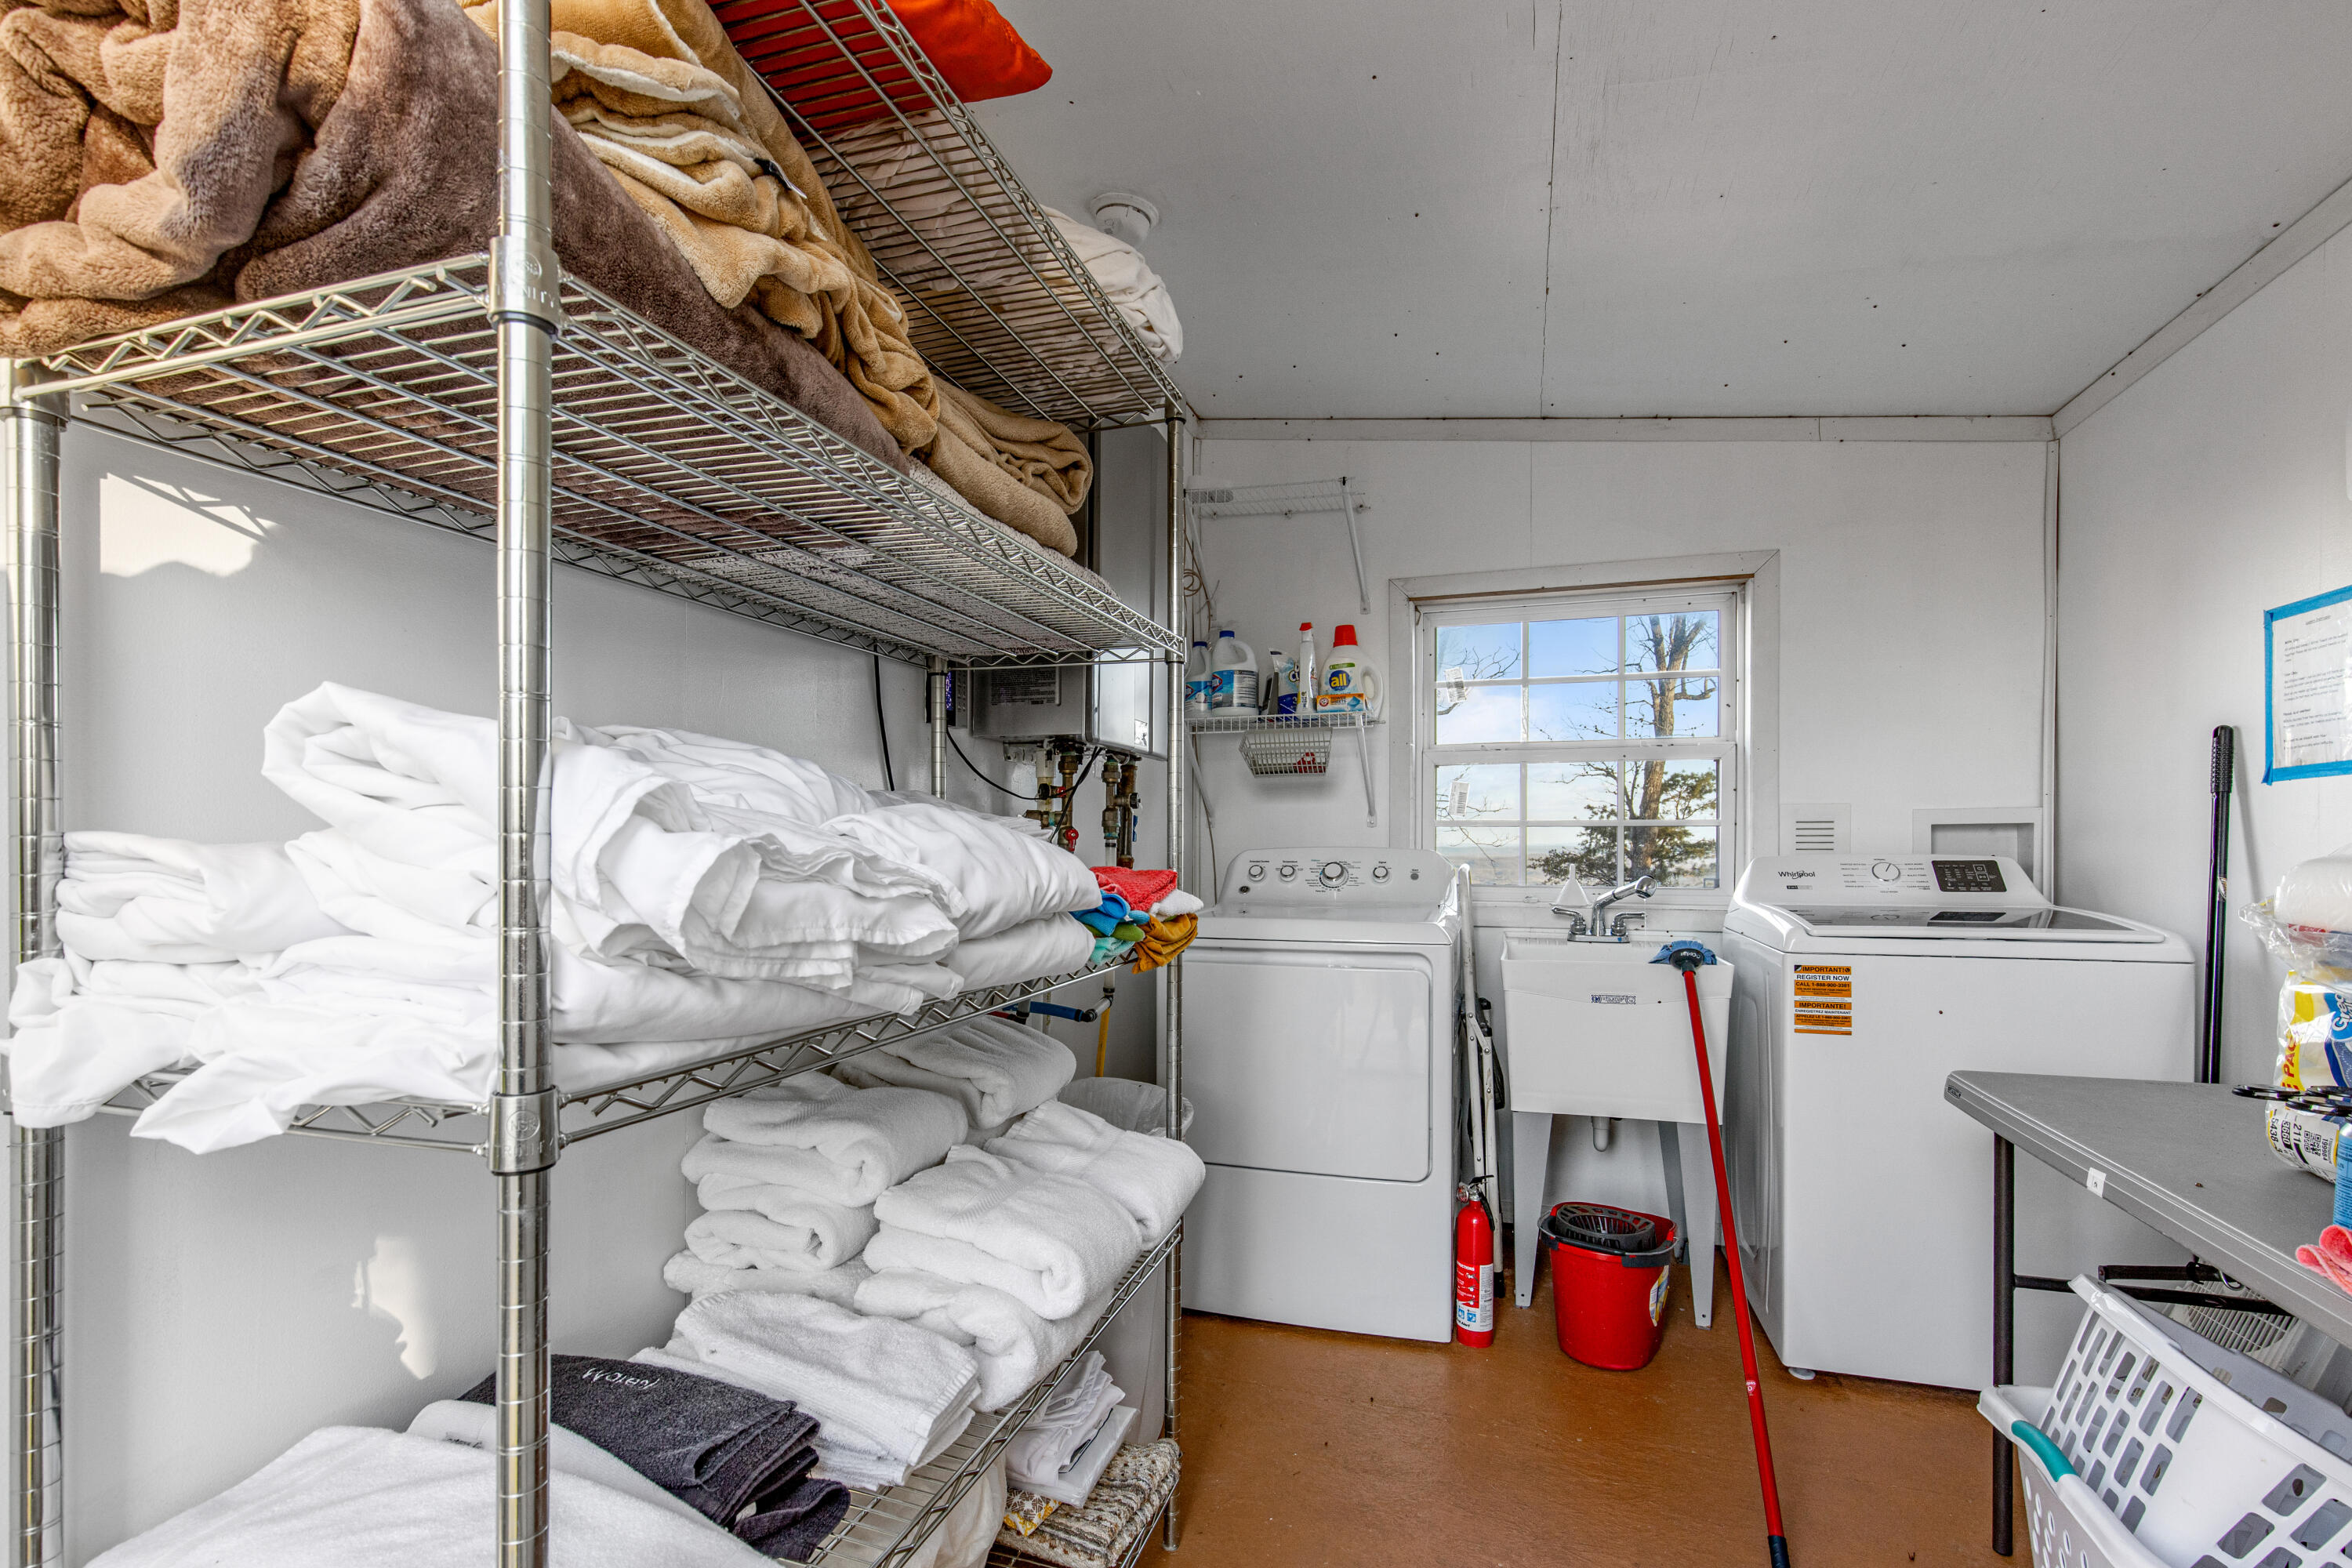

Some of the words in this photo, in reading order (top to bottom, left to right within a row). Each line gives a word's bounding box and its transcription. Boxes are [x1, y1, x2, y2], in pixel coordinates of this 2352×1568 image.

[1331, 673, 1348, 687] all
[1778, 870, 1816, 879] Whirlpool
[2332, 991, 2350, 1031] Grea
[2283, 1030, 2296, 1078] PAC
[2270, 1117, 2279, 1142] 5438
[2282, 1120, 2291, 1145] 3660
[2293, 1123, 2302, 1145] 211
